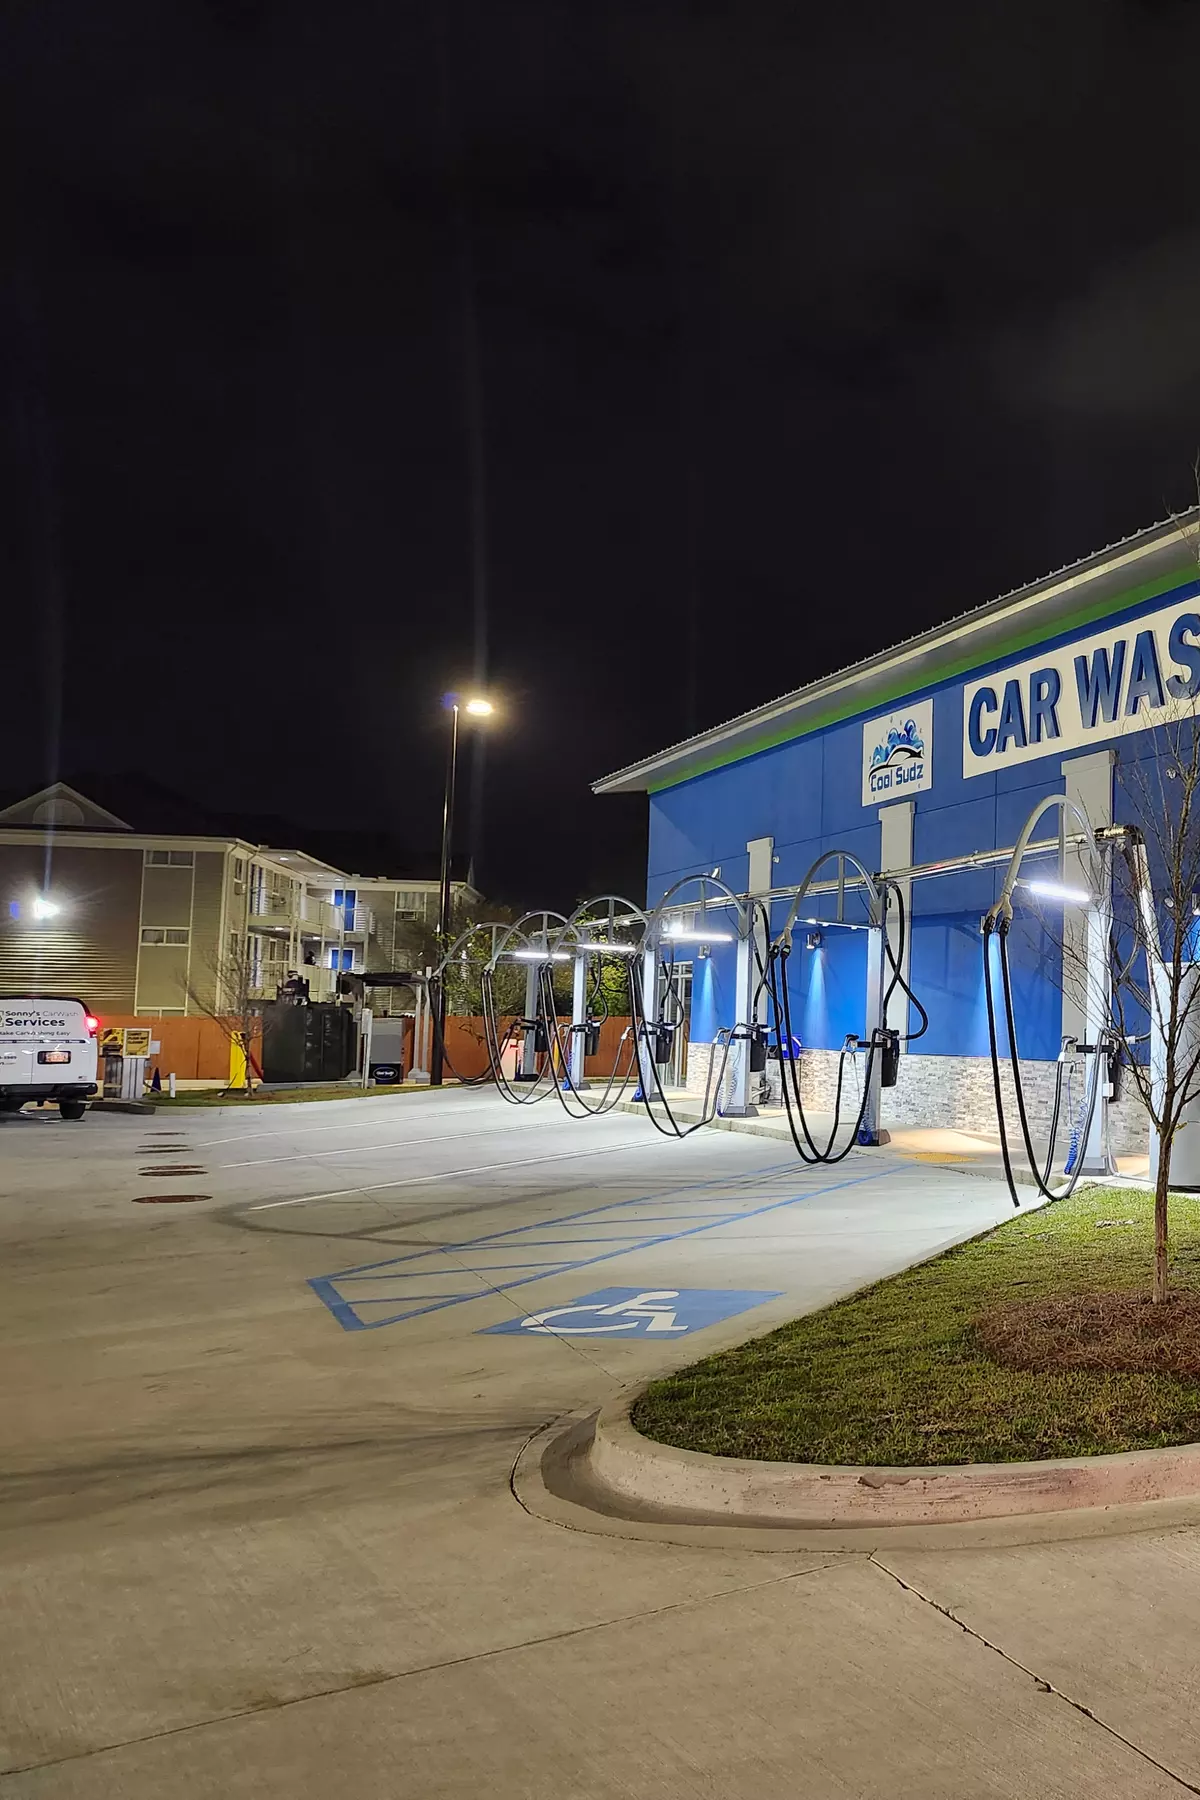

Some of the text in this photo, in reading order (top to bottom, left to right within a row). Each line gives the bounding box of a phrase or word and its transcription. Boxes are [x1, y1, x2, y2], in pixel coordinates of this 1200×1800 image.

[968, 667, 1063, 758] CAR
[870, 762, 924, 793] Cool Sudz
[5, 1010, 41, 1018] Sonny's
[5, 1017, 66, 1027] Services
